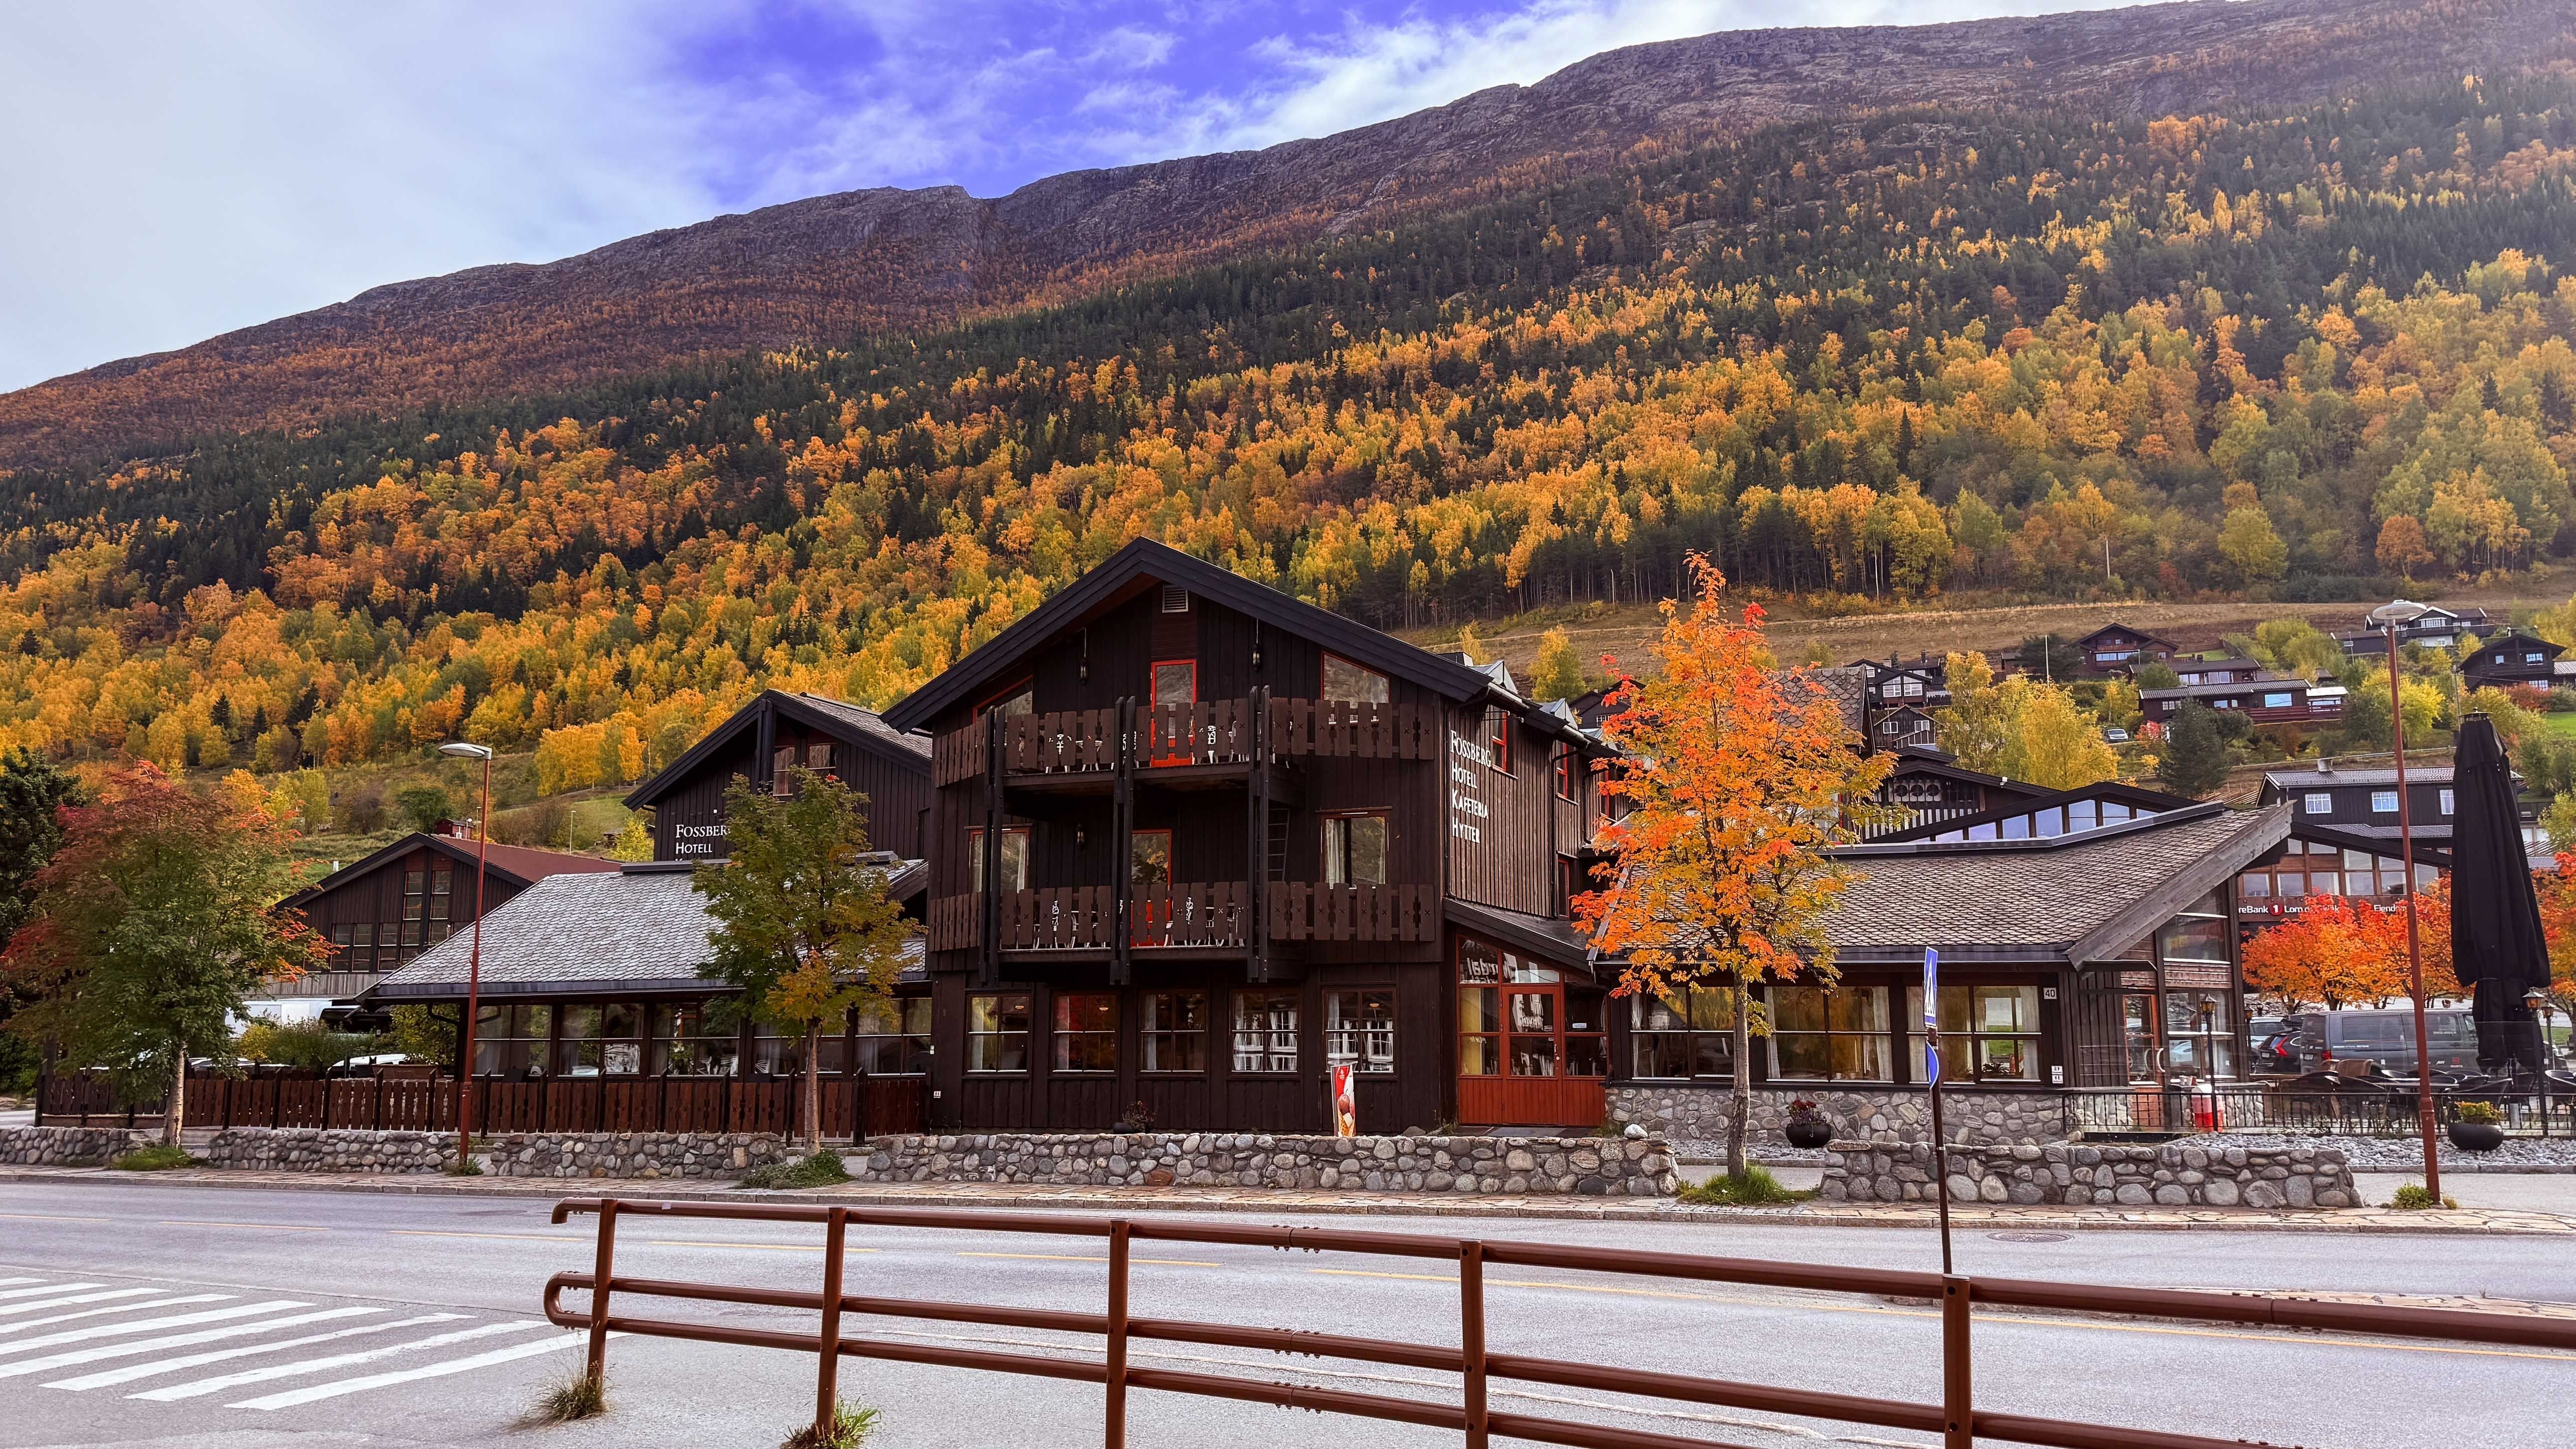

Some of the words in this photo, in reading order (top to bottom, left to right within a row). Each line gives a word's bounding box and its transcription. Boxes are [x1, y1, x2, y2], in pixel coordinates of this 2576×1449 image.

[1450, 730, 1492, 768] FOSSBERG
[1452, 761, 1477, 789] HOTELL
[1452, 789, 1489, 820] KAFETERIA
[675, 824, 731, 838] FOSSBER
[1452, 817, 1480, 843] HYTTER
[675, 842, 713, 854] HOTELL
[2273, 904, 2278, 913] 1
[2045, 989, 2055, 998] 40
